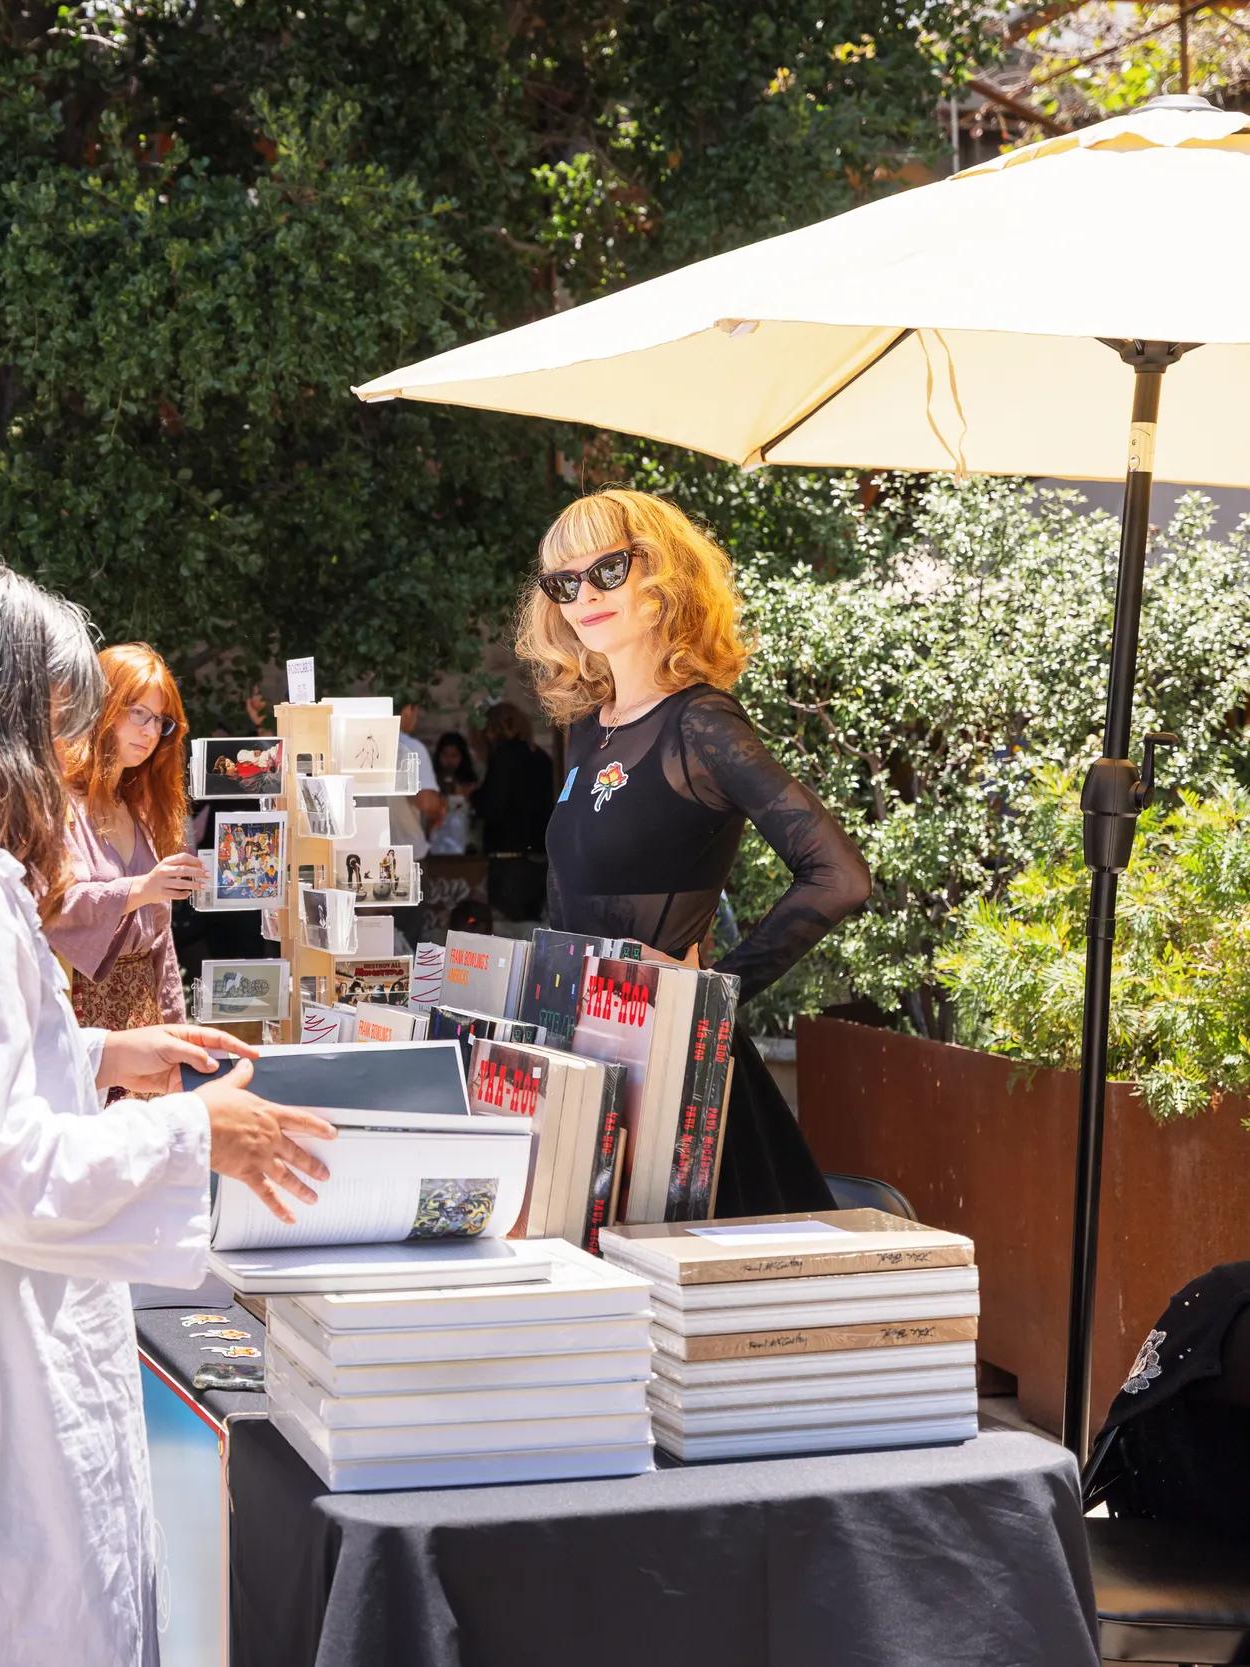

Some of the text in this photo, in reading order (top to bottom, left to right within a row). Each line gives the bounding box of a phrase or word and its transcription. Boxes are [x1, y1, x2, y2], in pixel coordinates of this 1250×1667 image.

[587, 975, 649, 1028] YAA-HOO
[694, 1019, 710, 1061] YAA-HOO
[715, 1020, 730, 1063] YAA-HOO
[478, 1059, 540, 1116] YAA-HOO
[684, 1105, 697, 1130] PAUL
[706, 1107, 719, 1131] PAUL
[592, 1200, 604, 1223] PAUL
